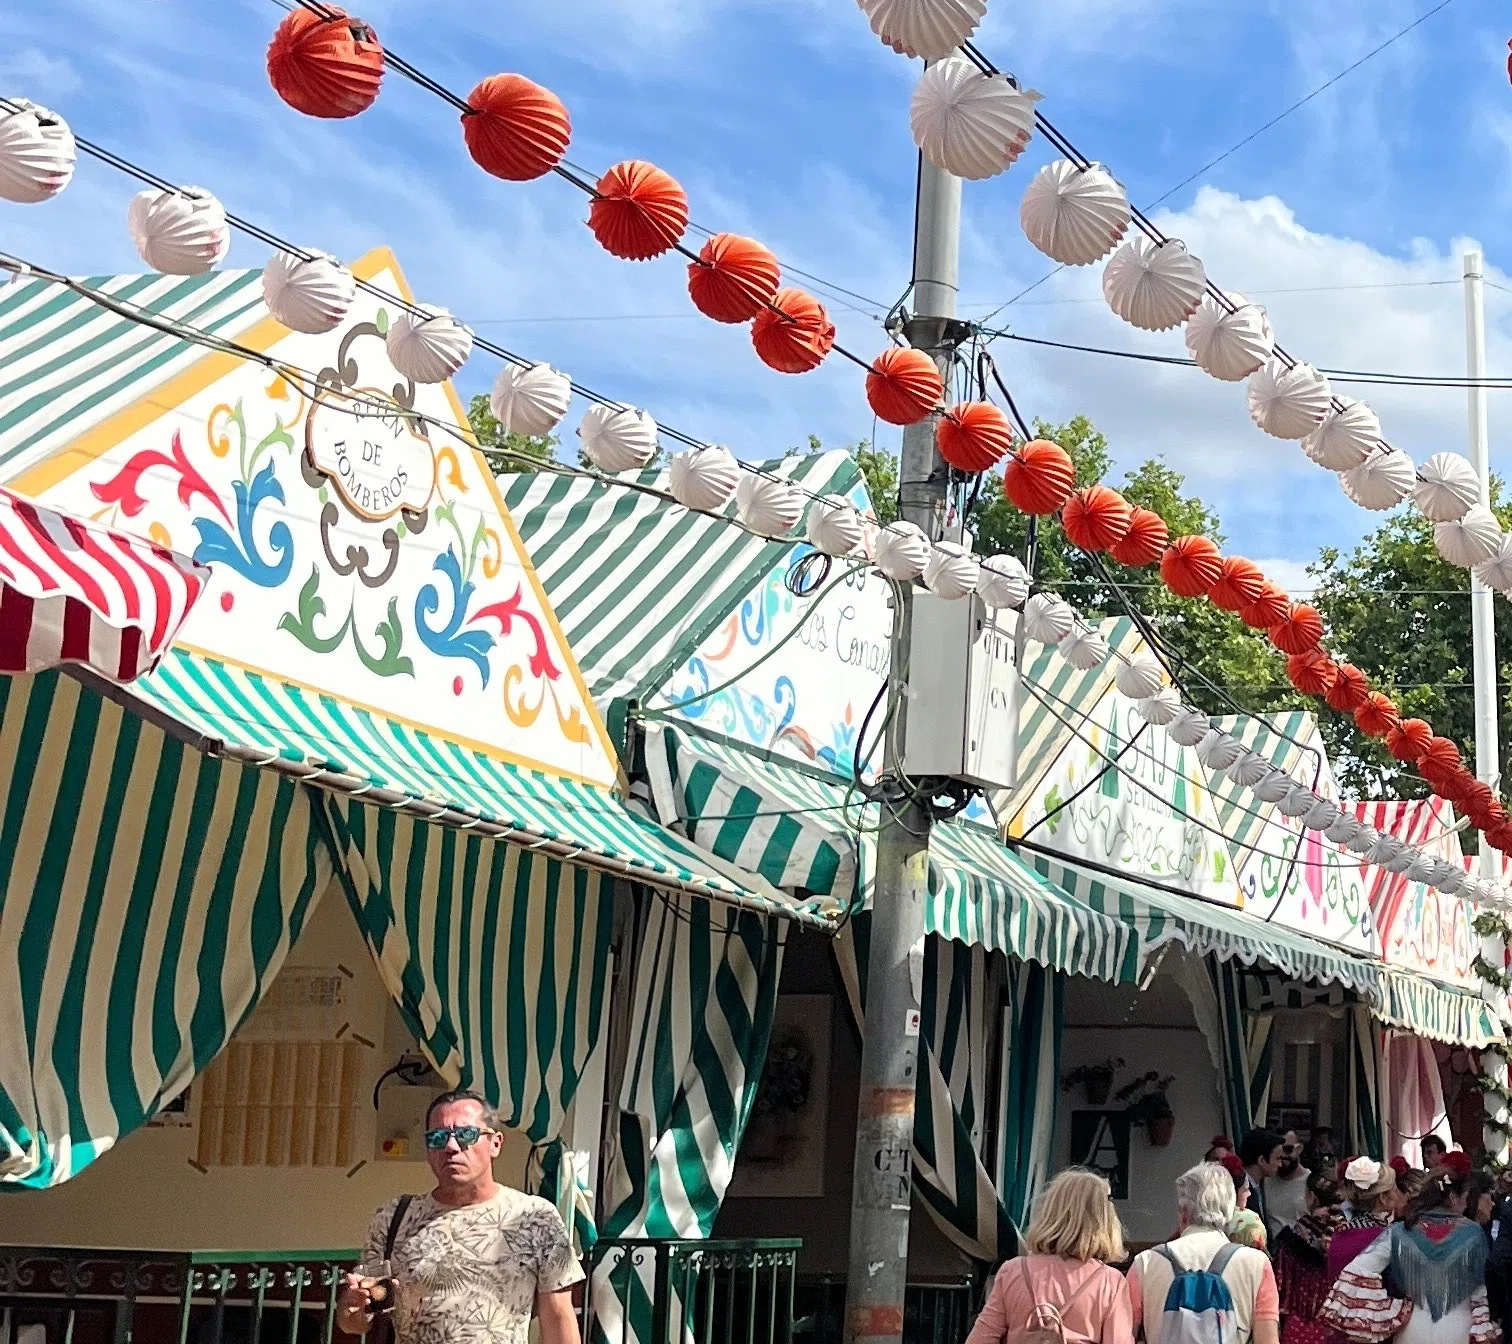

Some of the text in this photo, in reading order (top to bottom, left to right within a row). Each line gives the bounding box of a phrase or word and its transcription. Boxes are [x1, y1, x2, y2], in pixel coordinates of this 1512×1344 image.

[334, 439, 408, 511] BOMBEROS
[361, 440, 383, 467] DE
[1096, 696, 1188, 823] ASAJA
